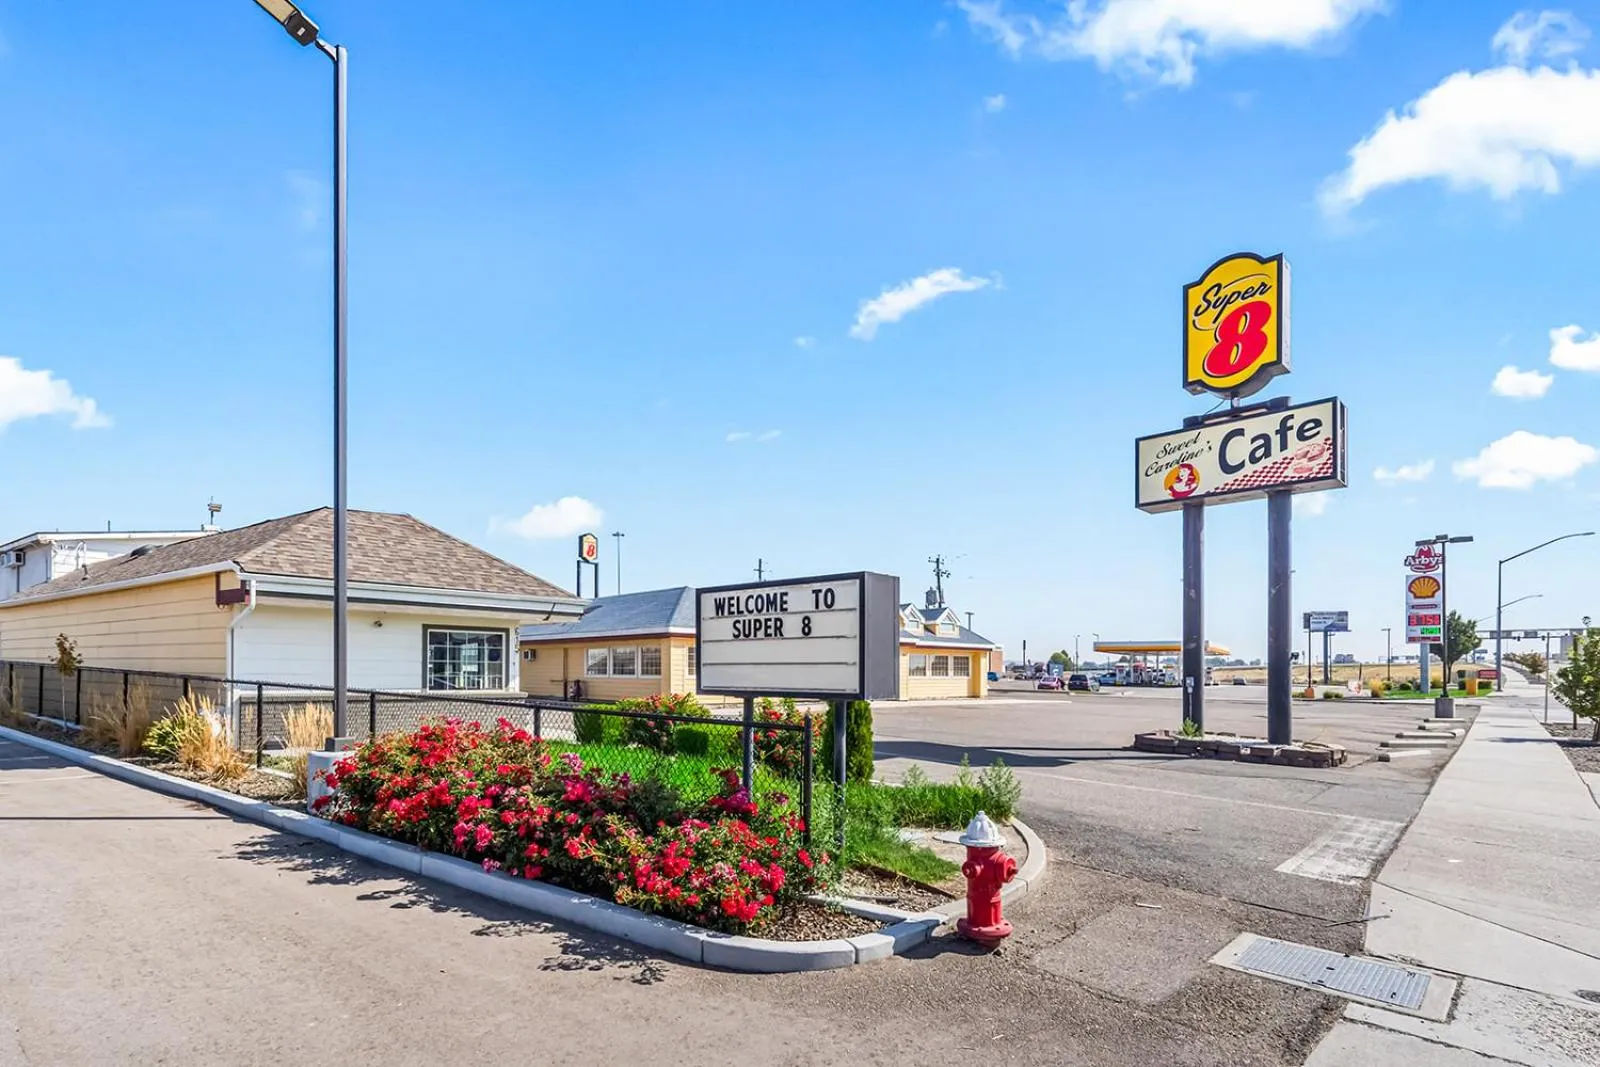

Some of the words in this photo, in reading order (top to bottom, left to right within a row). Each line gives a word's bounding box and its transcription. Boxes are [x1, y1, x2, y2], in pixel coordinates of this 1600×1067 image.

[1193, 278, 1273, 327] Super
[1202, 300, 1272, 378] 8
[1218, 413, 1323, 475] Cafe
[713, 592, 789, 616] WELCOME
[812, 588, 836, 610] TO
[732, 617, 784, 639] SUPER
[801, 616, 812, 637] 8
